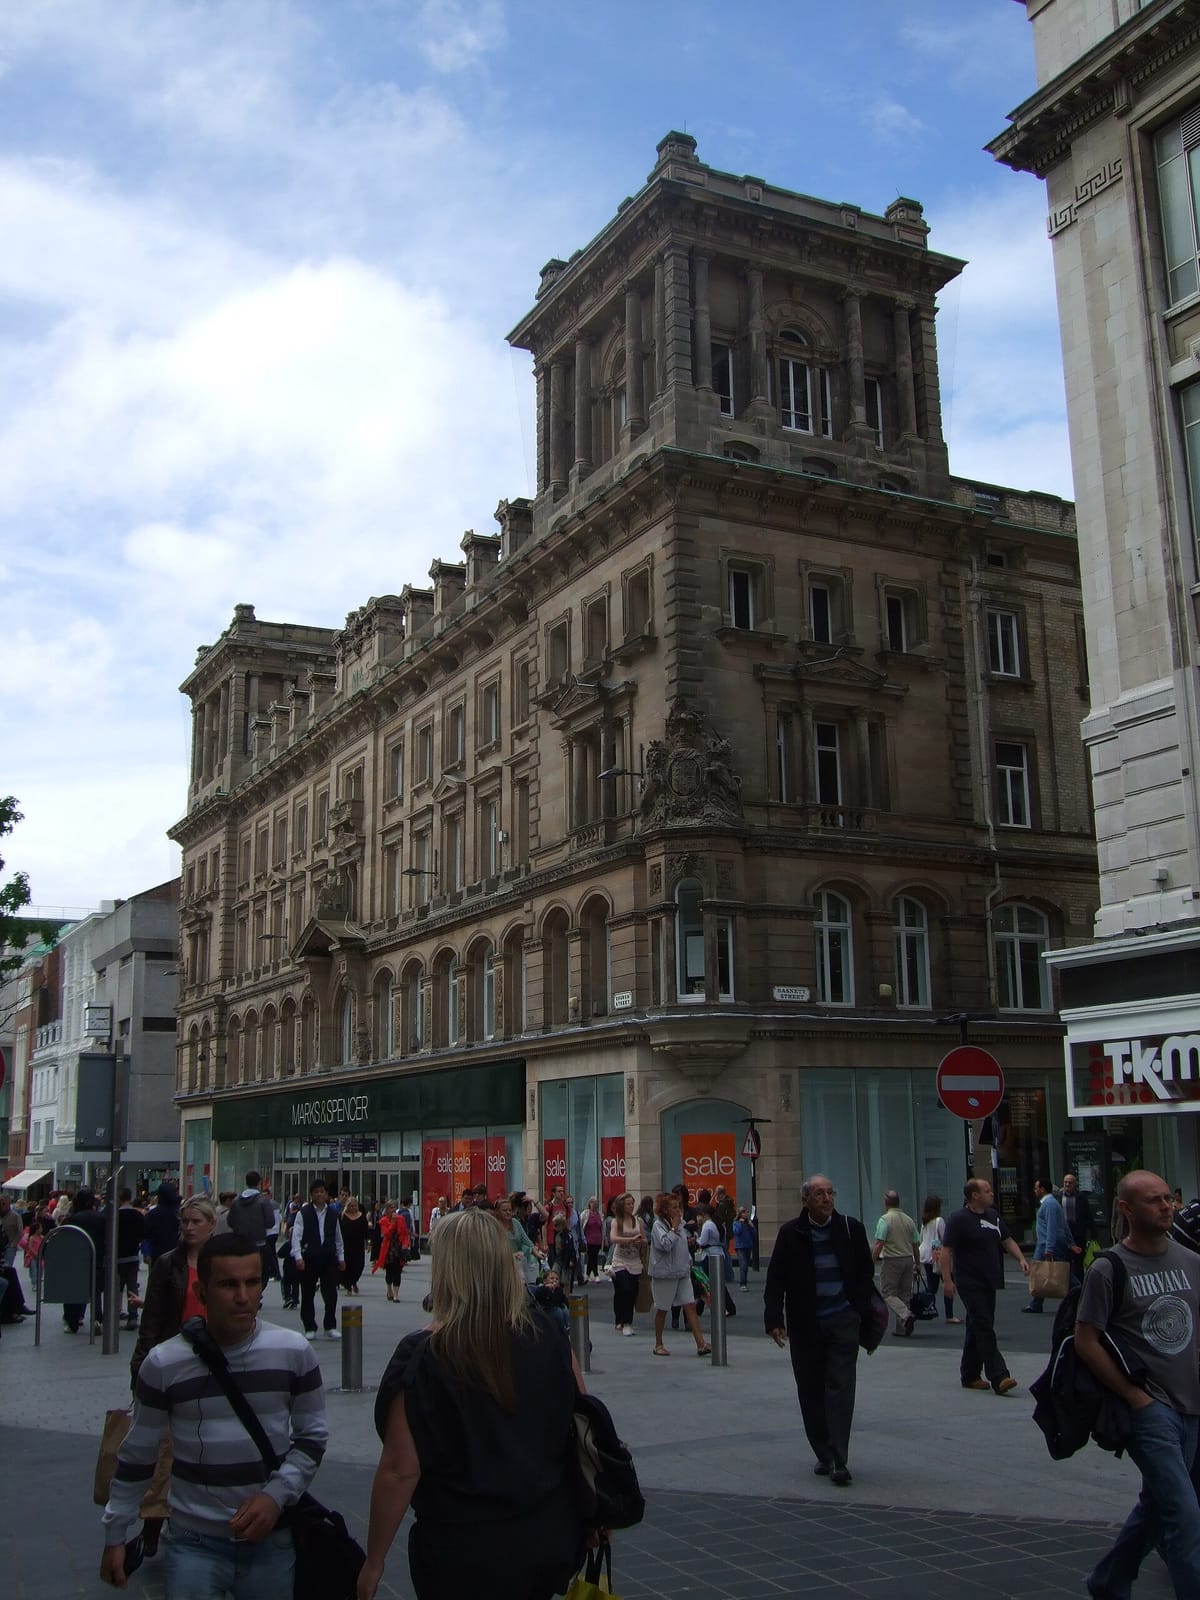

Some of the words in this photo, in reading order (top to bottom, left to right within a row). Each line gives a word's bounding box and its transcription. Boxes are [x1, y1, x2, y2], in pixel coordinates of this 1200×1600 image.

[454, 1152, 470, 1173] sale
[487, 1150, 506, 1172] sale
[545, 1153, 566, 1177] sale
[602, 1152, 626, 1177] sale
[684, 1150, 735, 1176] sale
[1130, 1269, 1192, 1298] NIRVANA
